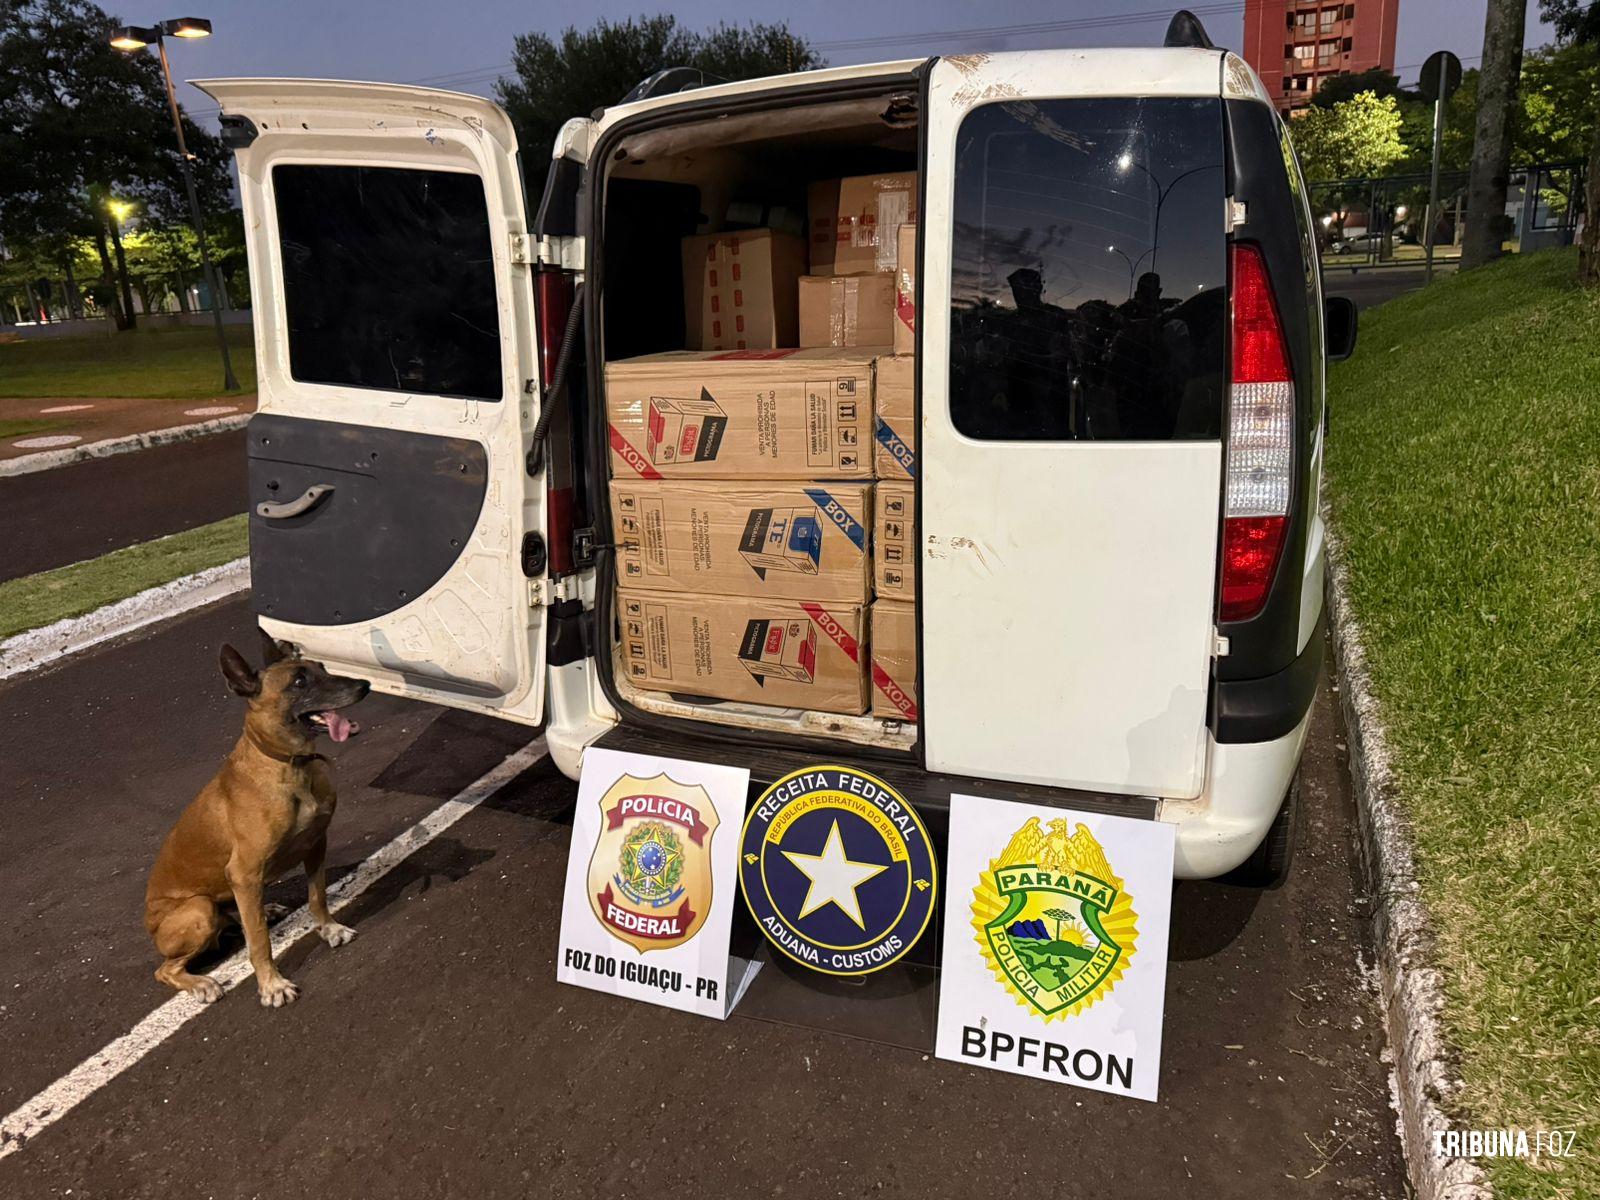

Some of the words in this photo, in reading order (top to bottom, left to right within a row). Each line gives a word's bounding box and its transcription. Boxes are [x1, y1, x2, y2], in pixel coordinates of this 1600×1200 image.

[756, 393, 764, 433] PROHIBIDA
[770, 412, 776, 422] DE
[619, 441, 647, 473] BOX
[770, 424, 778, 458] MENORES
[885, 435, 915, 468] BOX
[769, 518, 787, 544] TE
[824, 500, 855, 532] BOX
[693, 542, 698, 551] DE
[703, 531, 712, 570] PROHIBIDA
[817, 613, 848, 643] BOX
[882, 680, 912, 711] BOX
[757, 772, 829, 823] RECEITA
[838, 773, 917, 842] FEDERAL
[769, 801, 809, 841] REPÚBLICA
[809, 795, 867, 814] FEDERATIVA
[867, 809, 881, 824] DO
[880, 822, 904, 859] BRASIL
[1001, 872, 1111, 905] PARANÁ
[606, 903, 682, 936] FEDERAL
[763, 915, 820, 964] ADUANA
[831, 935, 903, 969] CUSTOMS
[564, 948, 592, 970] FOZ
[594, 955, 617, 978] DO
[620, 960, 682, 993] IGUAÇU
[695, 977, 718, 1000] PR
[991, 931, 1040, 998] POLÍCIA
[1055, 949, 1112, 1002] MILITAR
[961, 1025, 1134, 1090] BPFRON
